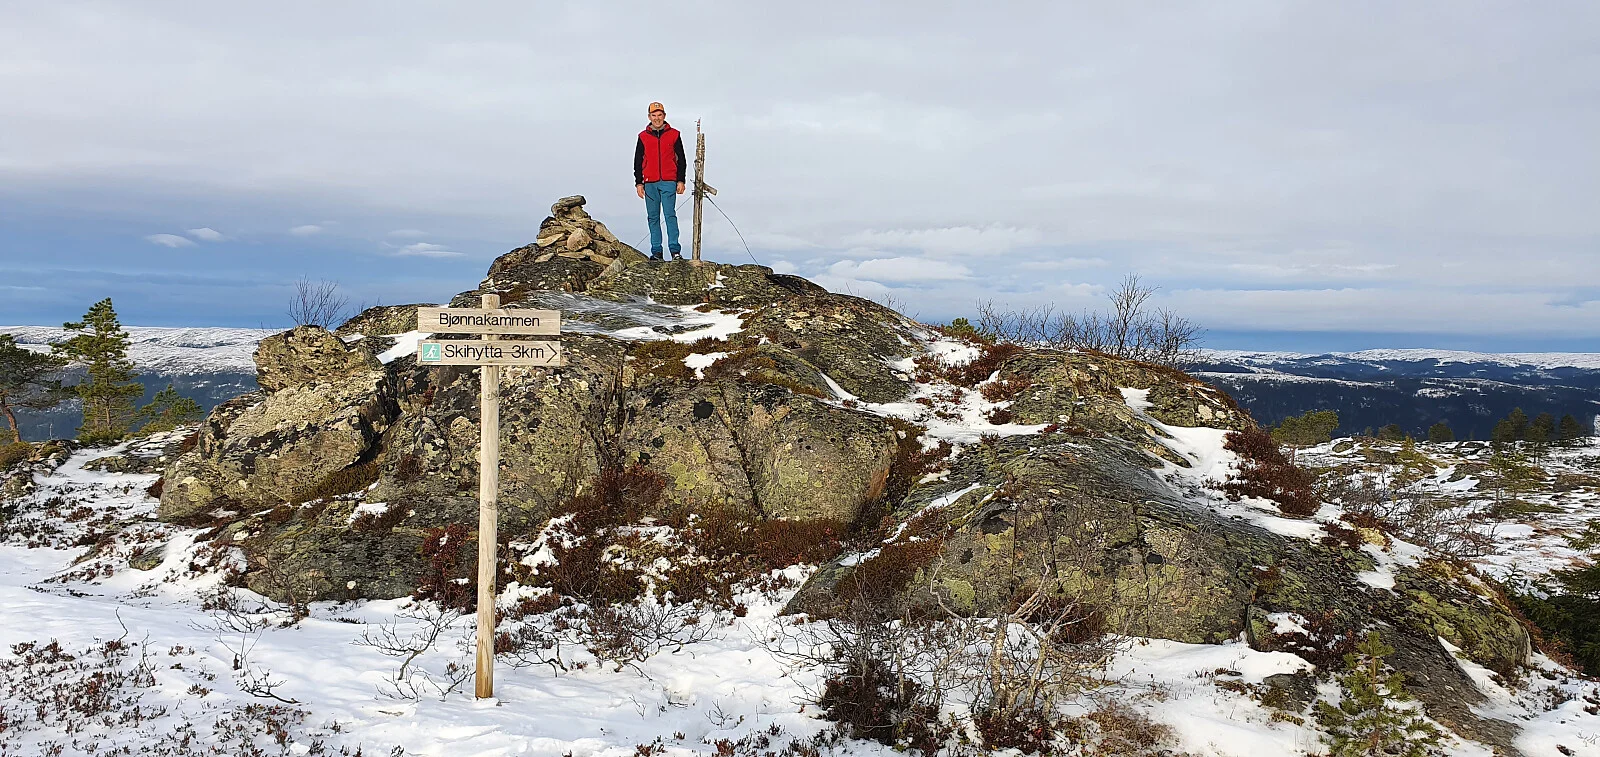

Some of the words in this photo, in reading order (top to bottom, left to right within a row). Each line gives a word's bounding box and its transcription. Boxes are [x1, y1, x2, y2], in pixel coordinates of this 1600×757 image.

[439, 313, 540, 327] Bjønnakammen
[444, 344, 503, 360] Skihytta
[511, 345, 544, 358] 3km
